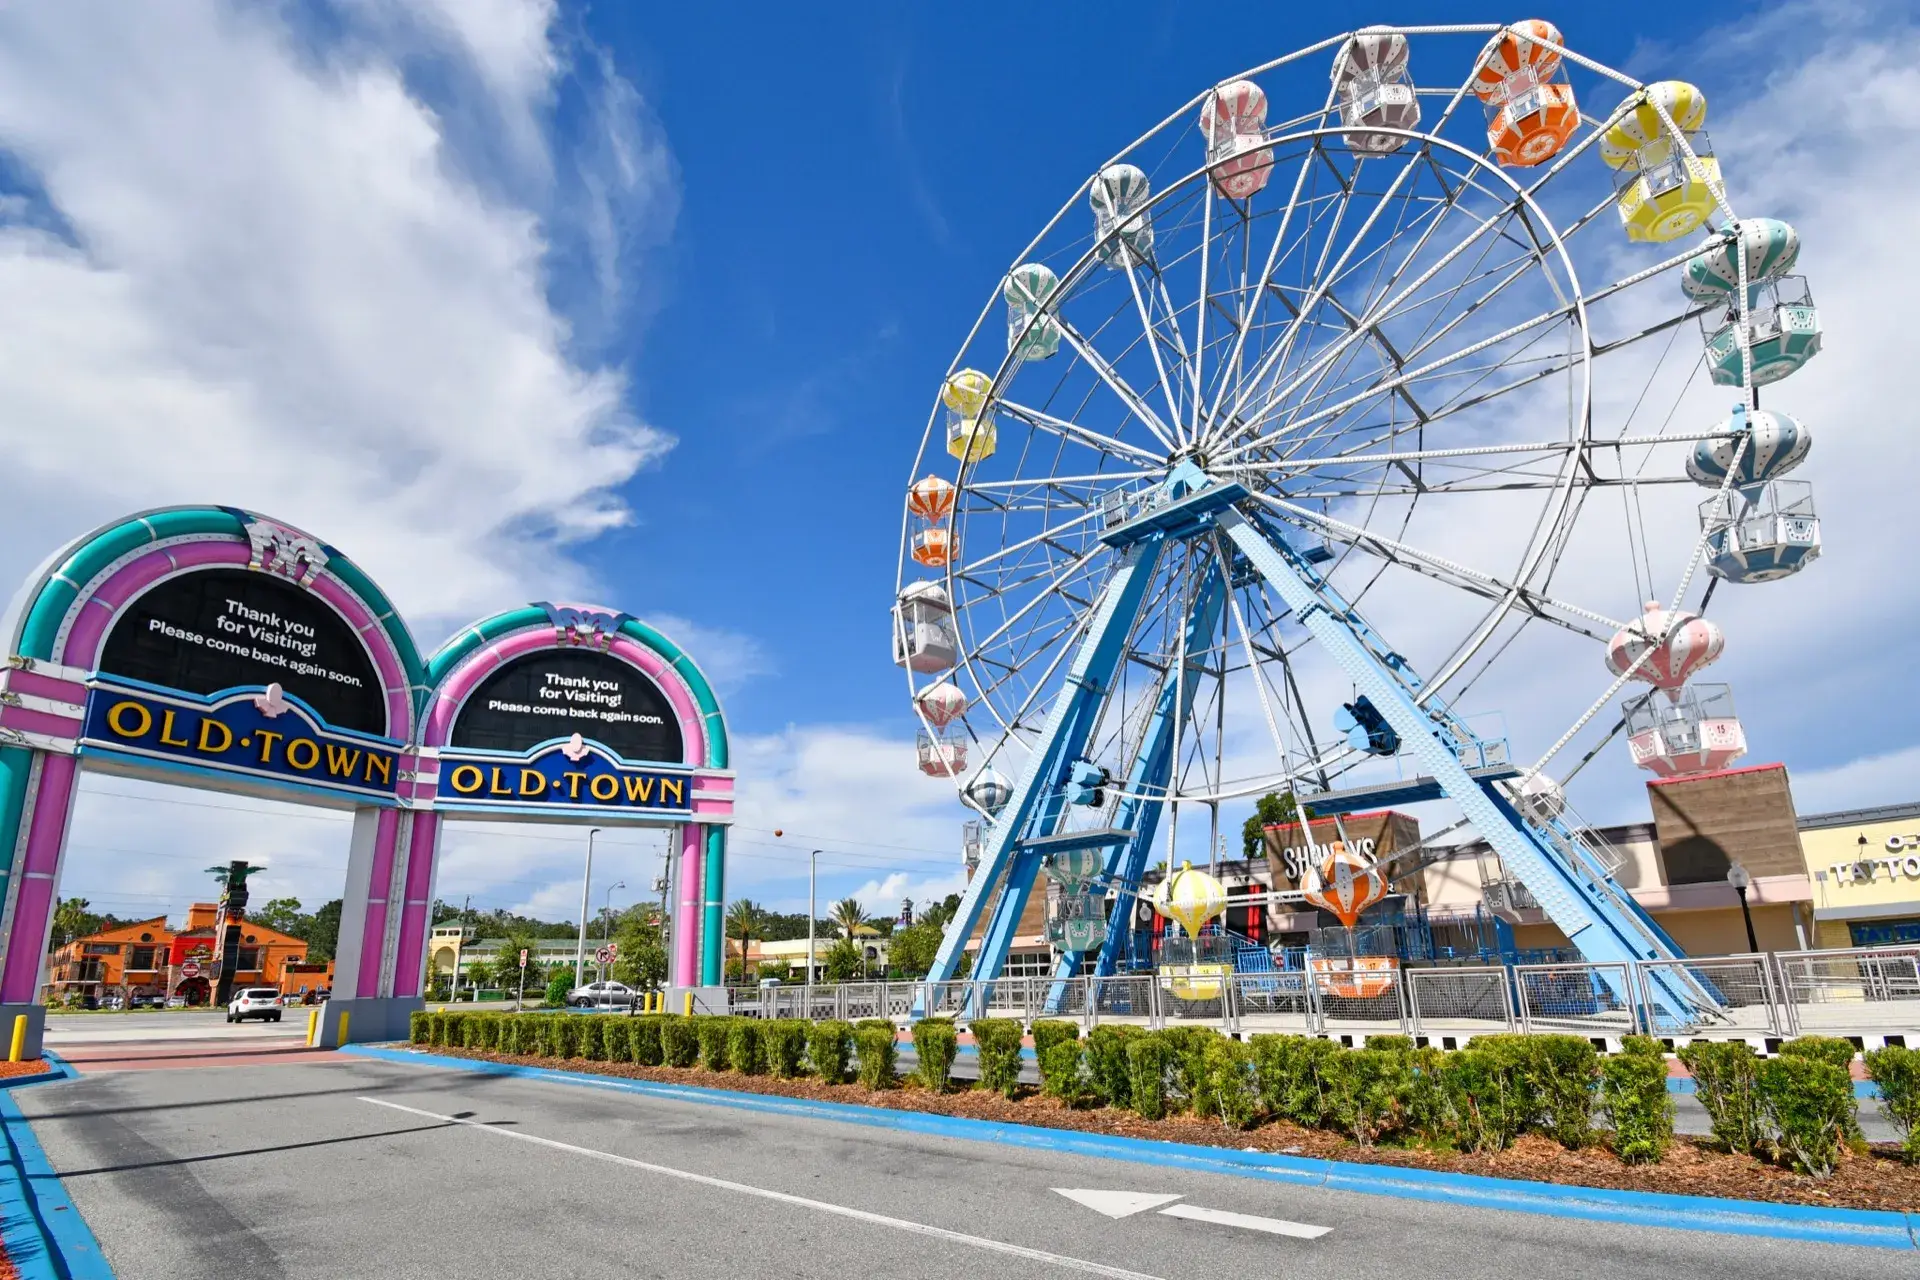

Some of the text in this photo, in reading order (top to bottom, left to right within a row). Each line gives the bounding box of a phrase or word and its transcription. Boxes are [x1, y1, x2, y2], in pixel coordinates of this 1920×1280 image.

[1796, 310, 1805, 320] 13
[1795, 520, 1804, 530] 14
[226, 599, 315, 638] Thank you
[216, 616, 317, 657] for Visiting!
[149, 619, 363, 688] Please come back again soon.
[545, 672, 619, 692] Thank you
[539, 686, 622, 708] for Visiting!
[488, 699, 664, 725] Please come back again soon.
[1717, 724, 1726, 734] 15
